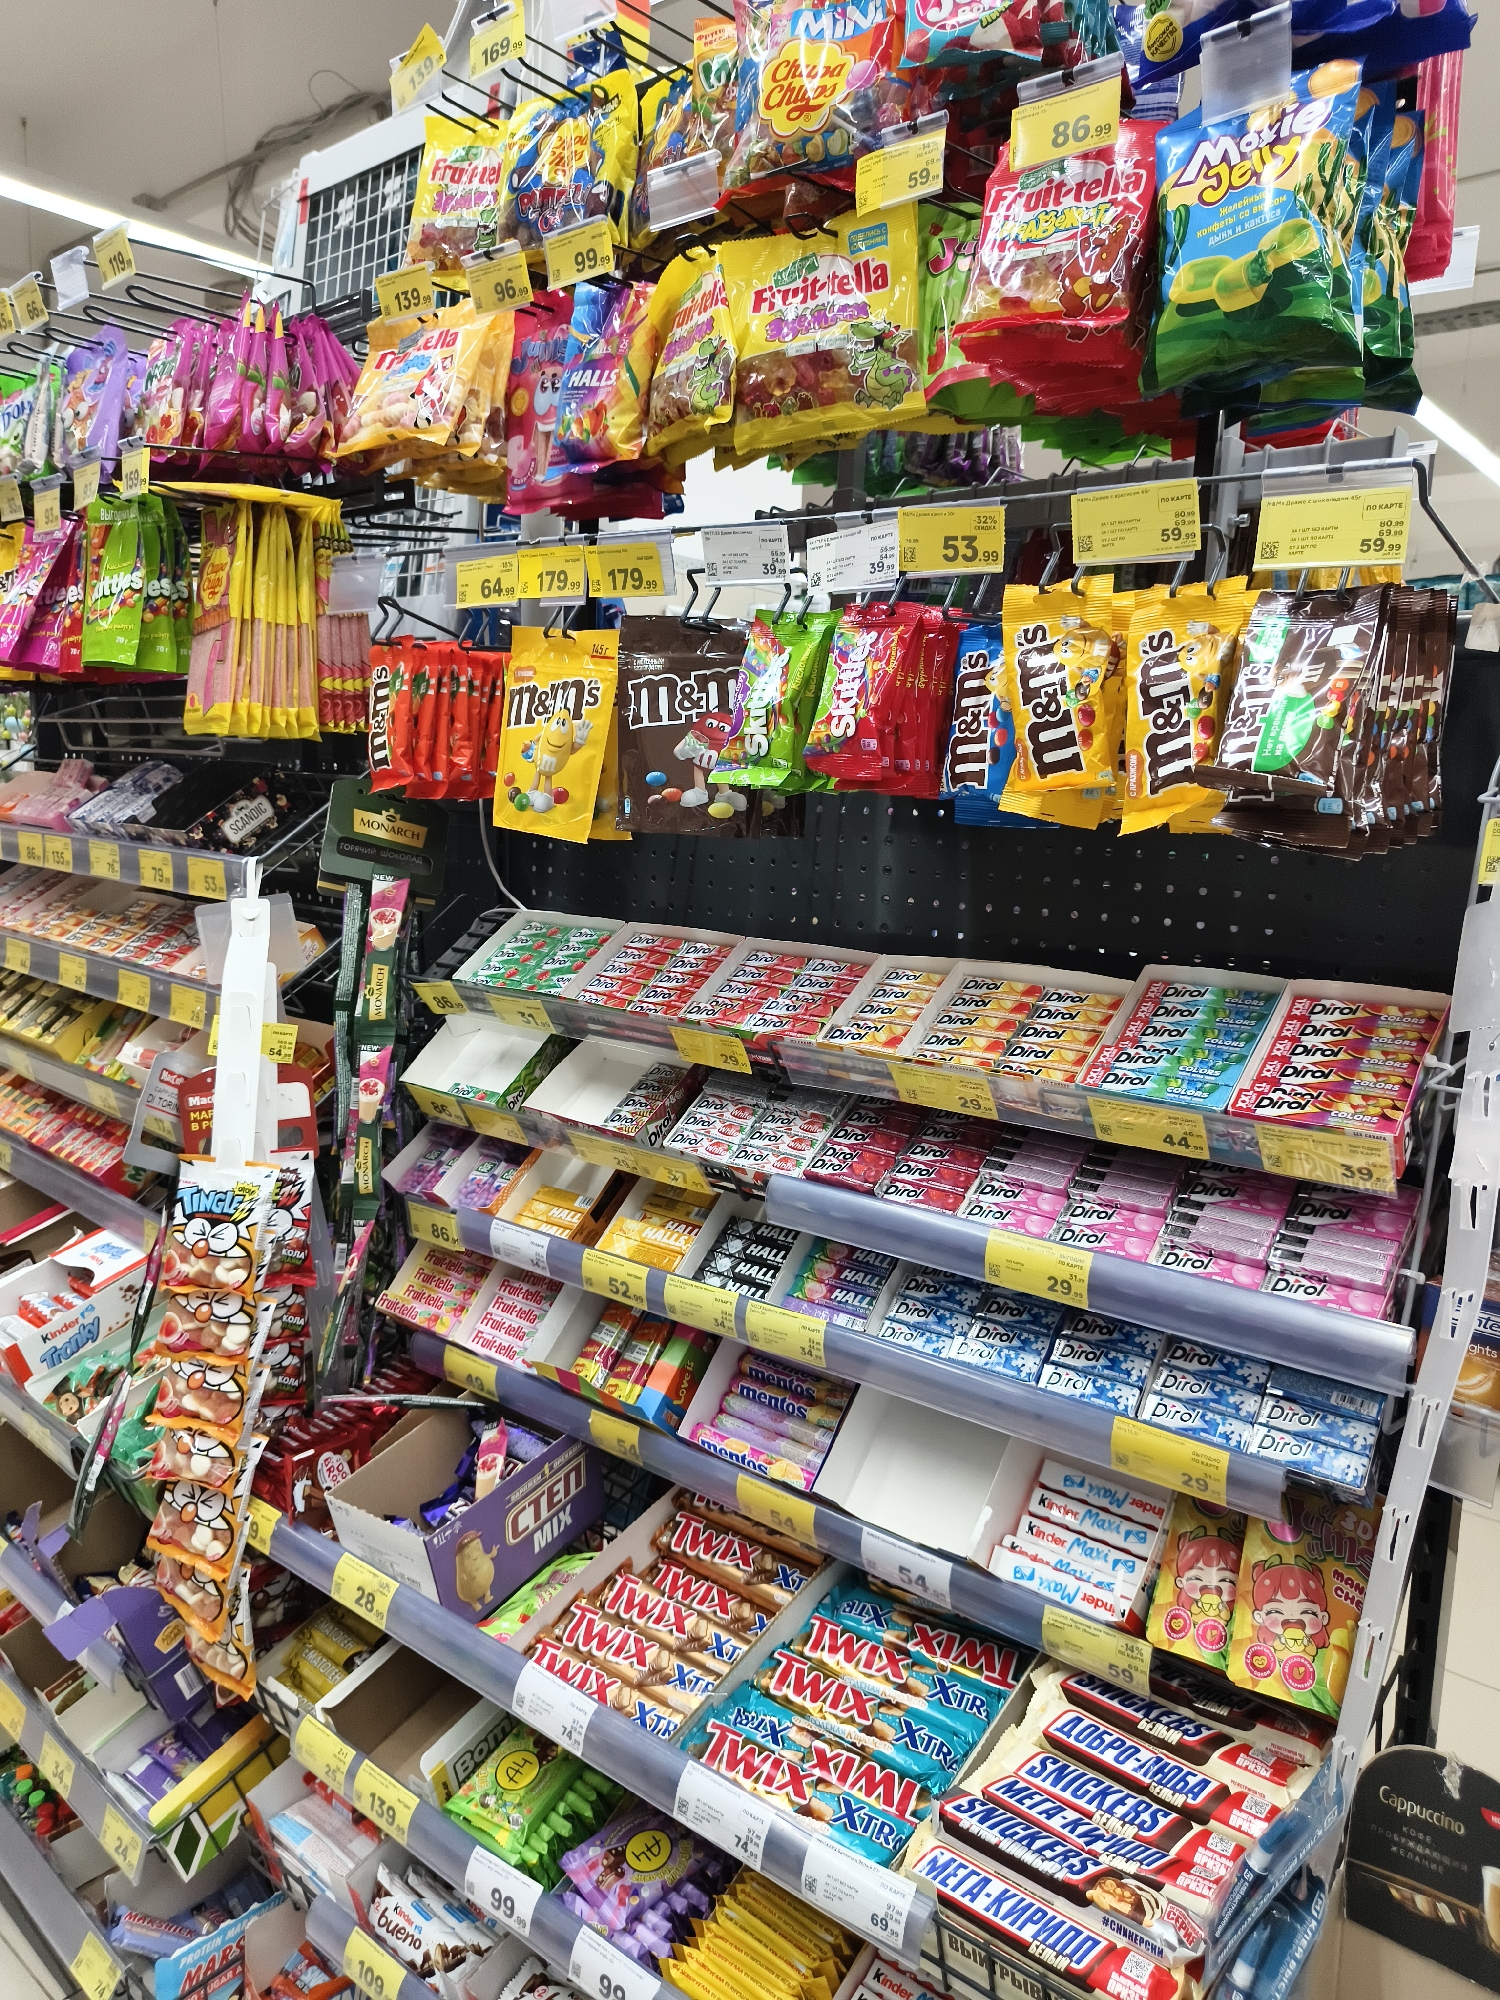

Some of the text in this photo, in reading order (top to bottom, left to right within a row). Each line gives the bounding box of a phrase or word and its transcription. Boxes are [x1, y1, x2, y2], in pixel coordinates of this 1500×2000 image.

[482, 37, 523, 65] 169.99
[771, 55, 847, 84] Chupa
[764, 79, 838, 121] Chups
[1051, 113, 1112, 149] 86.99
[1176, 100, 1328, 186] Moxie
[907, 168, 940, 189] 59.99
[1202, 137, 1300, 203] Jelly
[1197, 210, 1250, 239] конфеты со
[1208, 225, 1242, 247] дыни и
[574, 248, 611, 273] 99.99
[394, 287, 432, 312] 139.99
[494, 278, 528, 302] 96.99
[567, 368, 617, 388] HALLS
[1171, 494, 1192, 502] КАРТЕ
[1366, 504, 1377, 512] ПО
[973, 515, 997, 525] -32%
[1174, 511, 1196, 519] 80.99
[1174, 519, 1196, 527] 69.99
[1379, 520, 1404, 528] 80.99
[1160, 527, 1196, 542] 59.99
[1359, 537, 1402, 554] 59.99
[1378, 529, 1403, 537] 69.99
[942, 535, 999, 563] 53.99
[537, 569, 582, 593] 179.99
[607, 567, 658, 592] 179.99
[762, 563, 786, 576] 39.99
[869, 561, 895, 574] 39.99
[480, 578, 515, 599] 64.99
[507, 677, 601, 728] m&m's
[1016, 624, 1085, 778] m&m's
[1140, 629, 1195, 796] m&m's
[1261, 736, 1271, 757] Нет
[230, 802, 267, 835] SCANDIC
[359, 817, 420, 841] MONARCH
[340, 842, 423, 865] ГОРЯЧИЙ ШОКОЛАД
[373, 873, 394, 881] NEW
[524, 922, 547, 932] Dirol
[545, 956, 570, 968] Dirol
[687, 945, 715, 956] Dirol
[746, 953, 778, 965] Dirol
[374, 966, 385, 1019] MONARCH
[661, 973, 689, 986] Dirol
[434, 994, 465, 1010] 86.99
[686, 1003, 720, 1018] Dirol
[1225, 997, 1265, 1008] COLORS
[1291, 998, 1306, 1017] XXL
[937, 1013, 979, 1026] Dirol
[1380, 1014, 1426, 1026] COLORS
[361, 1044, 379, 1052] NEW
[828, 1029, 868, 1042] Dirol
[1204, 1037, 1246, 1049] COLORS
[1371, 1036, 1418, 1048] COLORS
[1179, 1066, 1222, 1078] COLORS
[1362, 1057, 1410, 1069] COLORS
[1166, 1086, 1209, 1099] COLORS
[433, 1101, 463, 1122] 86.99
[731, 1106, 754, 1121] White
[800, 1119, 824, 1134] White
[789, 1137, 813, 1153] White
[1163, 1133, 1204, 1152] 44.99
[362, 1141, 371, 1192] MONARCH
[1340, 1162, 1388, 1185] 39.99
[549, 1206, 582, 1224] HALL
[431, 1223, 459, 1246] 86.99
[281, 1248, 305, 1260] КОЛА
[1067, 1261, 1083, 1271] КАРТЕ
[414, 1267, 454, 1293] Fruit-tella
[500, 1278, 544, 1306] Fruit-tella
[608, 1276, 644, 1304] 52.99
[1046, 1275, 1084, 1299] 29.99
[377, 1293, 418, 1321] Fruit-tella
[403, 1283, 443, 1311] Fruit-tella
[491, 1296, 537, 1324] Fruit-tella
[41, 1316, 80, 1345] Kinder
[282, 1314, 305, 1327] КОЛА
[41, 1315, 101, 1370] Tronky
[277, 1376, 300, 1387] КОЛА
[674, 1371, 692, 1406] Love
[748, 1365, 815, 1401] mentos
[738, 1383, 808, 1420] mentos
[699, 1437, 768, 1475] mentos
[509, 1456, 585, 1544] СТЕП
[1087, 1481, 1131, 1509] Maxi
[1038, 1493, 1123, 1534] Kinder Maxi
[1341, 1510, 1373, 1539] 3D
[534, 1504, 574, 1554] MIX
[672, 1511, 762, 1570] TWIX
[1027, 1520, 1109, 1563] Kinder Maxi
[652, 1559, 740, 1617] TWIX
[1038, 1577, 1081, 1604] Maxi
[355, 1586, 384, 1621] 28.99
[604, 1573, 698, 1637] TWIX
[563, 1602, 659, 1669] TWIX
[805, 1614, 912, 1682] TWIX
[1119, 1640, 1144, 1657] -14%
[908, 1624, 1019, 1688] TWIX
[772, 1649, 879, 1724] TWIX
[1069, 1672, 1214, 1741] SNICKERS
[560, 1724, 580, 1747] 74.99
[1136, 1718, 1184, 1747] БЕЛЫЙ
[702, 1721, 816, 1801] TWIX
[1052, 1714, 1214, 1805] ДОБРО-ЛЮБА
[804, 1741, 922, 1825] TWIX
[1027, 1752, 1178, 1838] SNICKERS
[1149, 1780, 1190, 1808] БЕЛЫЙ
[1379, 1785, 1466, 1836] Cappuccino
[951, 1796, 1101, 1878] SNICKERS
[1092, 1810, 1138, 1840] БЕЛЫЙ
[733, 1833, 758, 1860] 74.99
[1370, 1823, 1468, 1874] ПРОБУЖДАЮЩИЙ
[1390, 1845, 1445, 1875] ЖЕЛАНИЕ
[889, 1885, 907, 1899] КАРТЕ
[392, 1901, 415, 1929] kinder
[490, 1887, 527, 1929] 99.99
[886, 1903, 903, 1917] 97.99
[923, 1850, 1103, 1967] МЕГА-КИРИЛЛ
[376, 1905, 422, 1951] bueno
[870, 1912, 900, 1939] 69.99
[179, 1937, 222, 1970] PROTEIN
[1028, 1939, 1076, 1973] БЕЛЫЙ
[872, 1967, 913, 2000] Kinder
